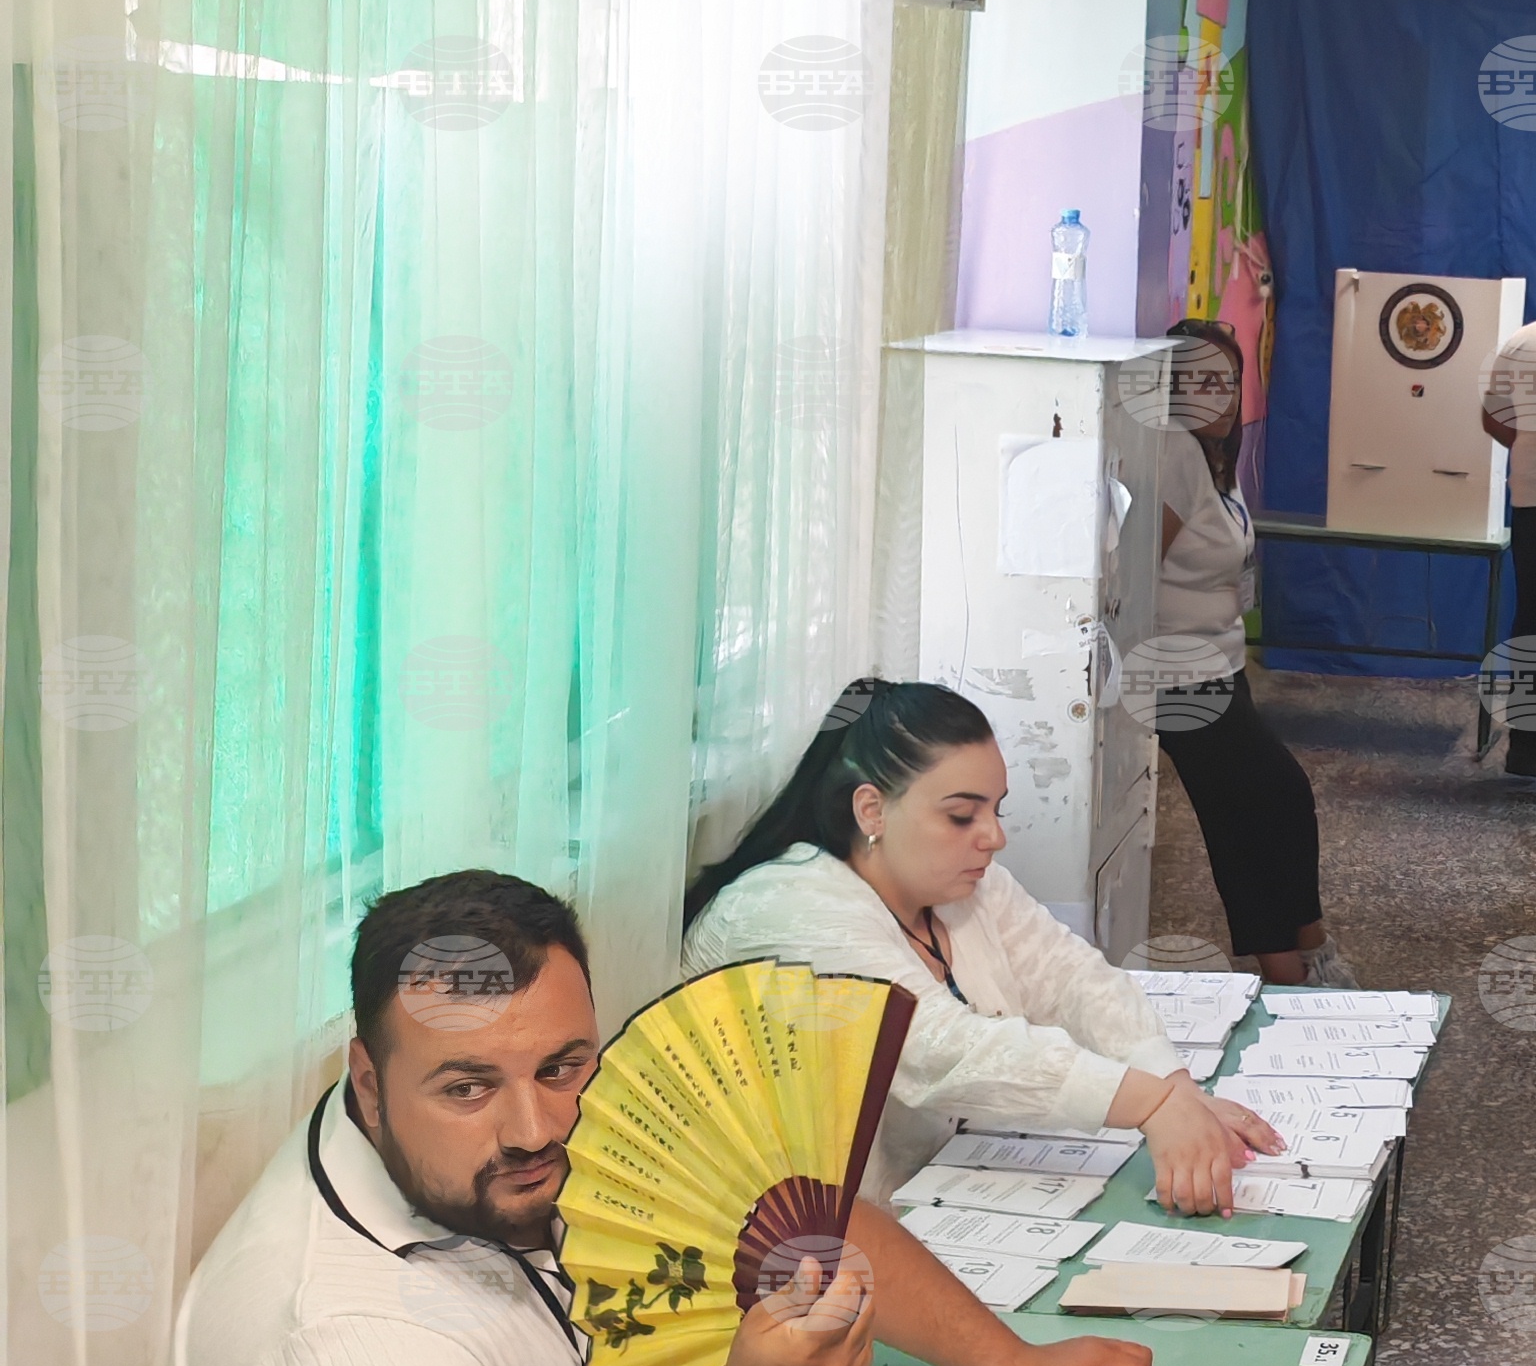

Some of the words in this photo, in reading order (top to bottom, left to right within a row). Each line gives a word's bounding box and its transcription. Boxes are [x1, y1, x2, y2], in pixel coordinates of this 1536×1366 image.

[1058, 1144, 1090, 1156] 16
[1026, 1221, 1062, 1235] 18
[1231, 1241, 1261, 1250] 8
[958, 1261, 996, 1275] 19
